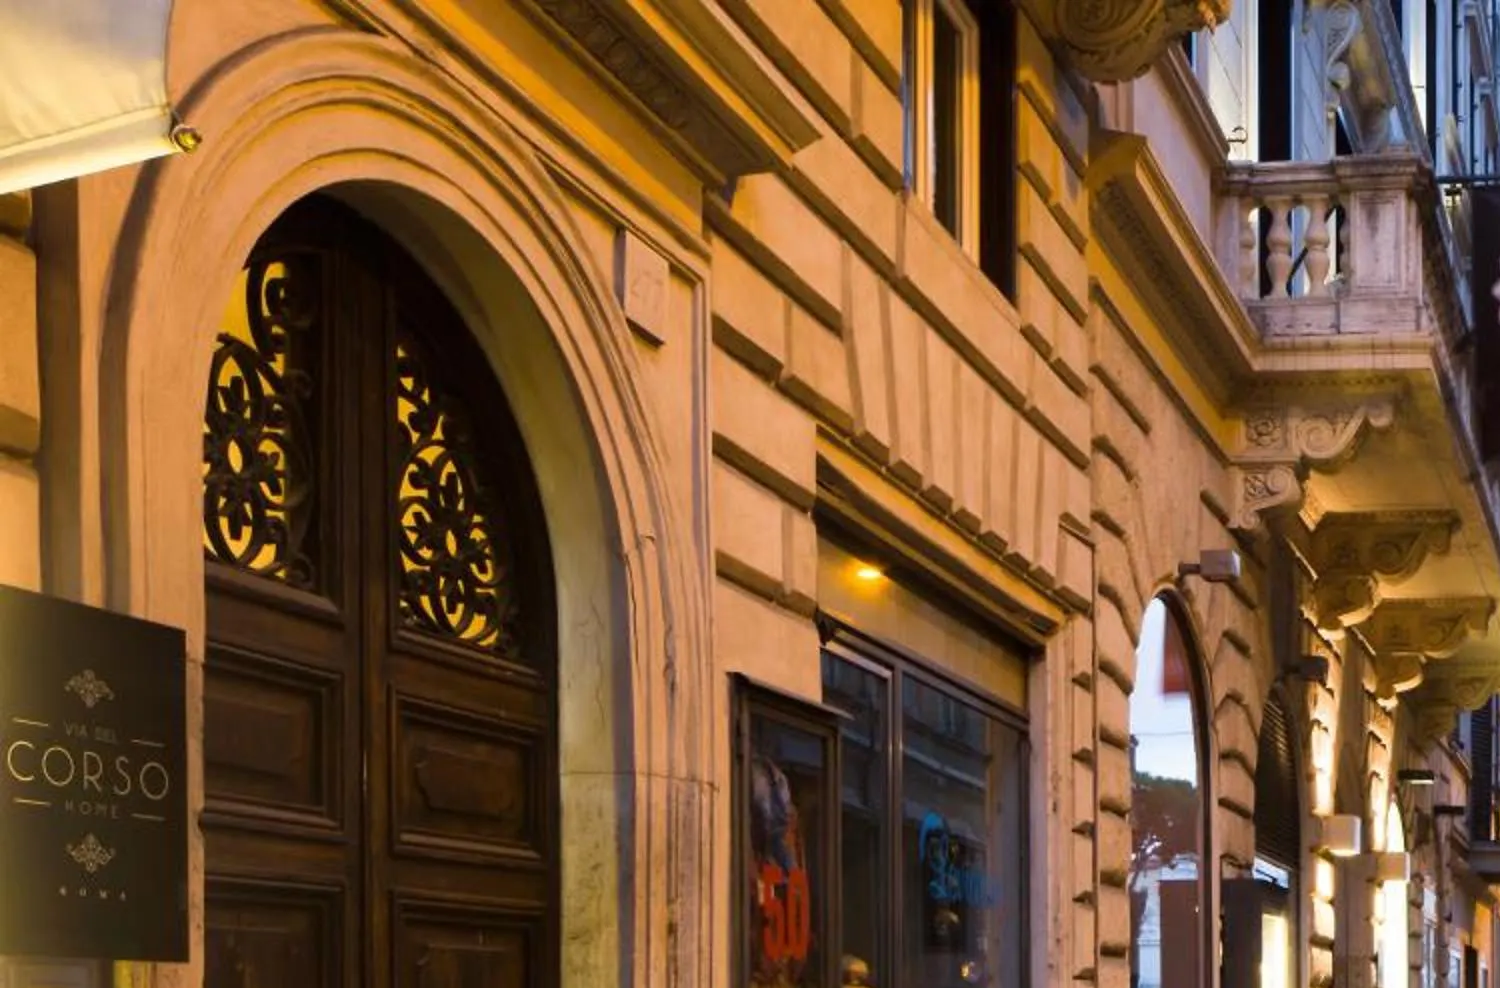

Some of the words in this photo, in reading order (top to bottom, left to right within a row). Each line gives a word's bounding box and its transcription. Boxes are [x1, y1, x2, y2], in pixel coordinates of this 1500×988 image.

[65, 722, 88, 738] VIA
[7, 740, 169, 800] CORSO
[65, 800, 120, 819] HOME
[762, 861, 812, 961] 50
